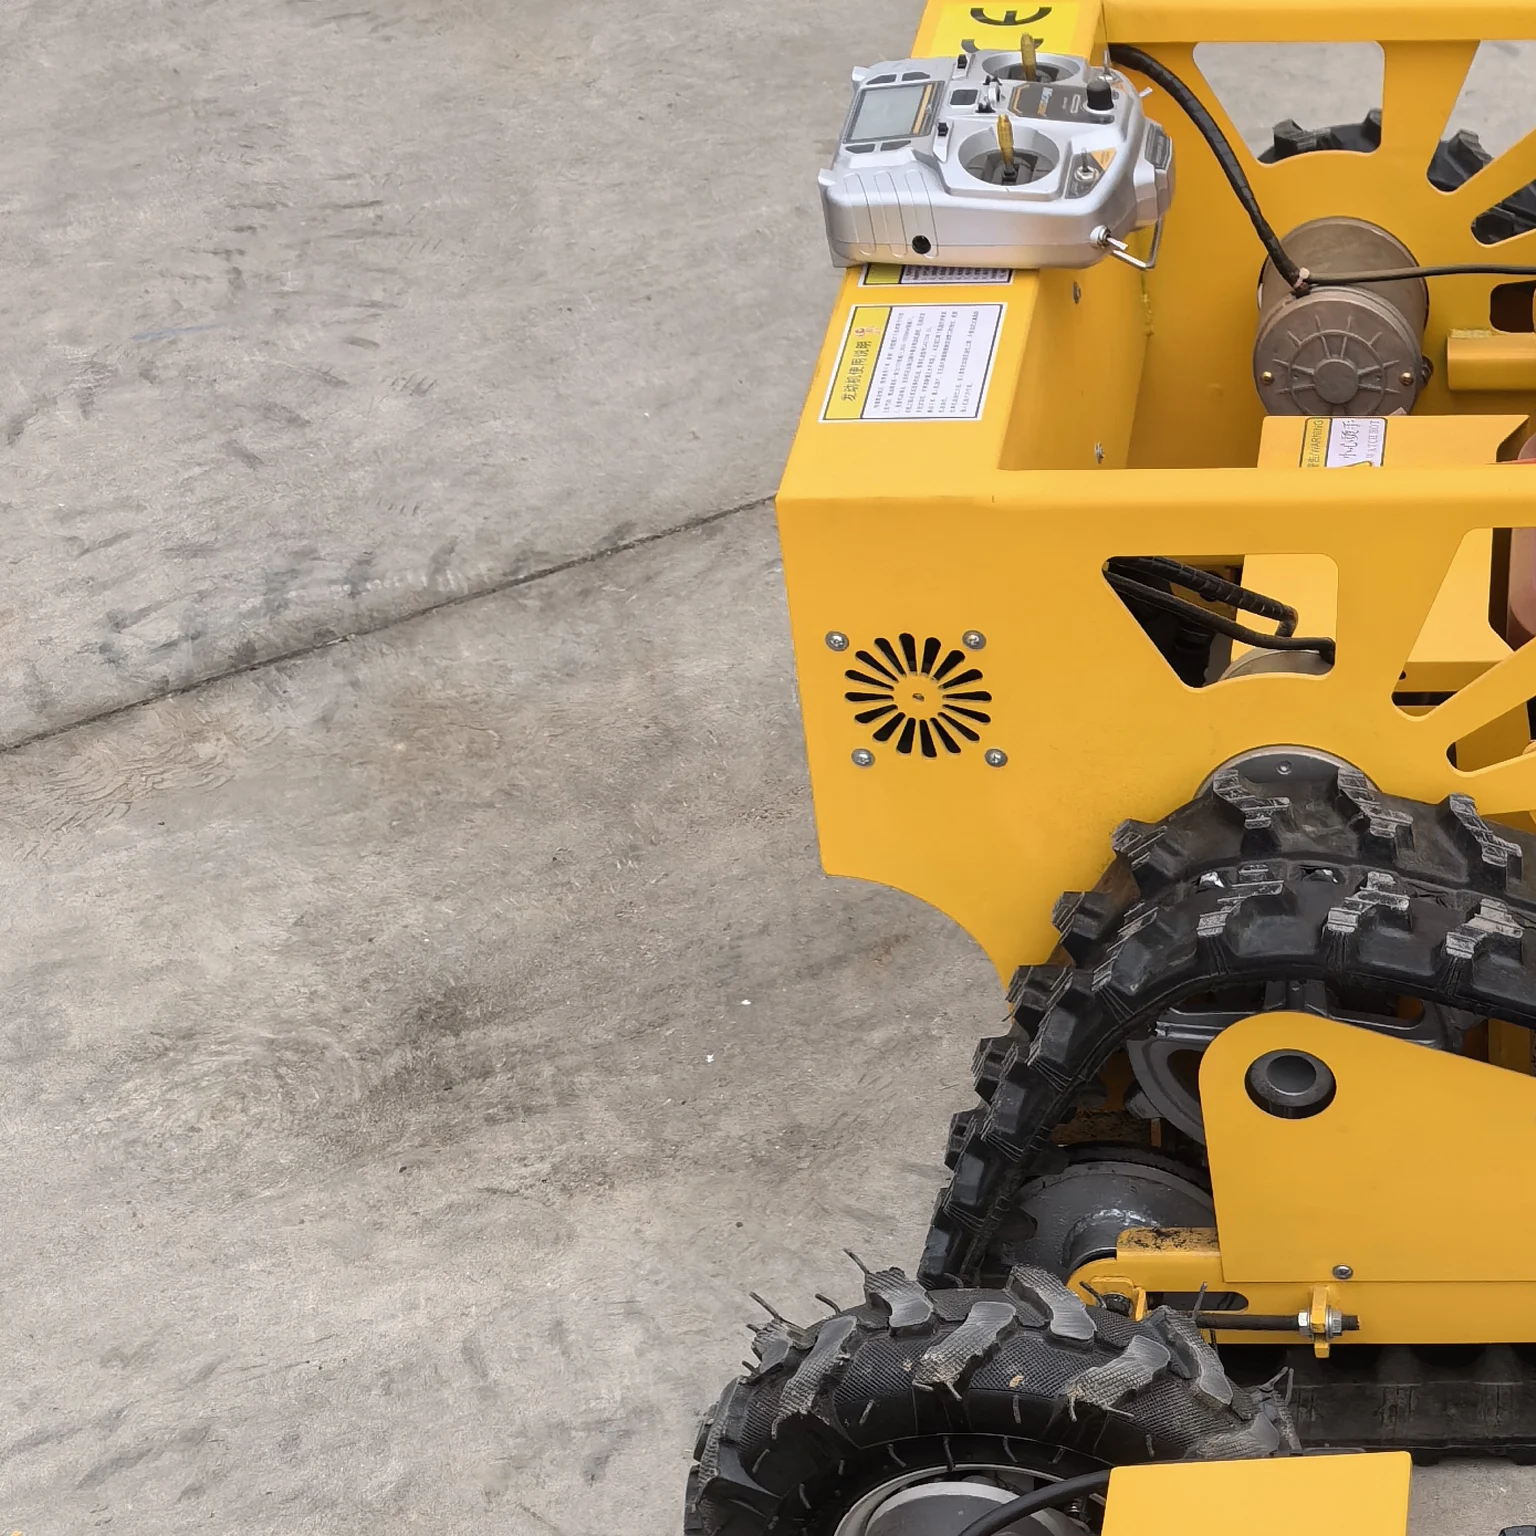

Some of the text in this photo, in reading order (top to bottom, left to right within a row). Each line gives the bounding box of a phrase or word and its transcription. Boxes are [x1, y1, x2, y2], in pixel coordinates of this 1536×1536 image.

[841, 340, 872, 402] 发动机使用说明
